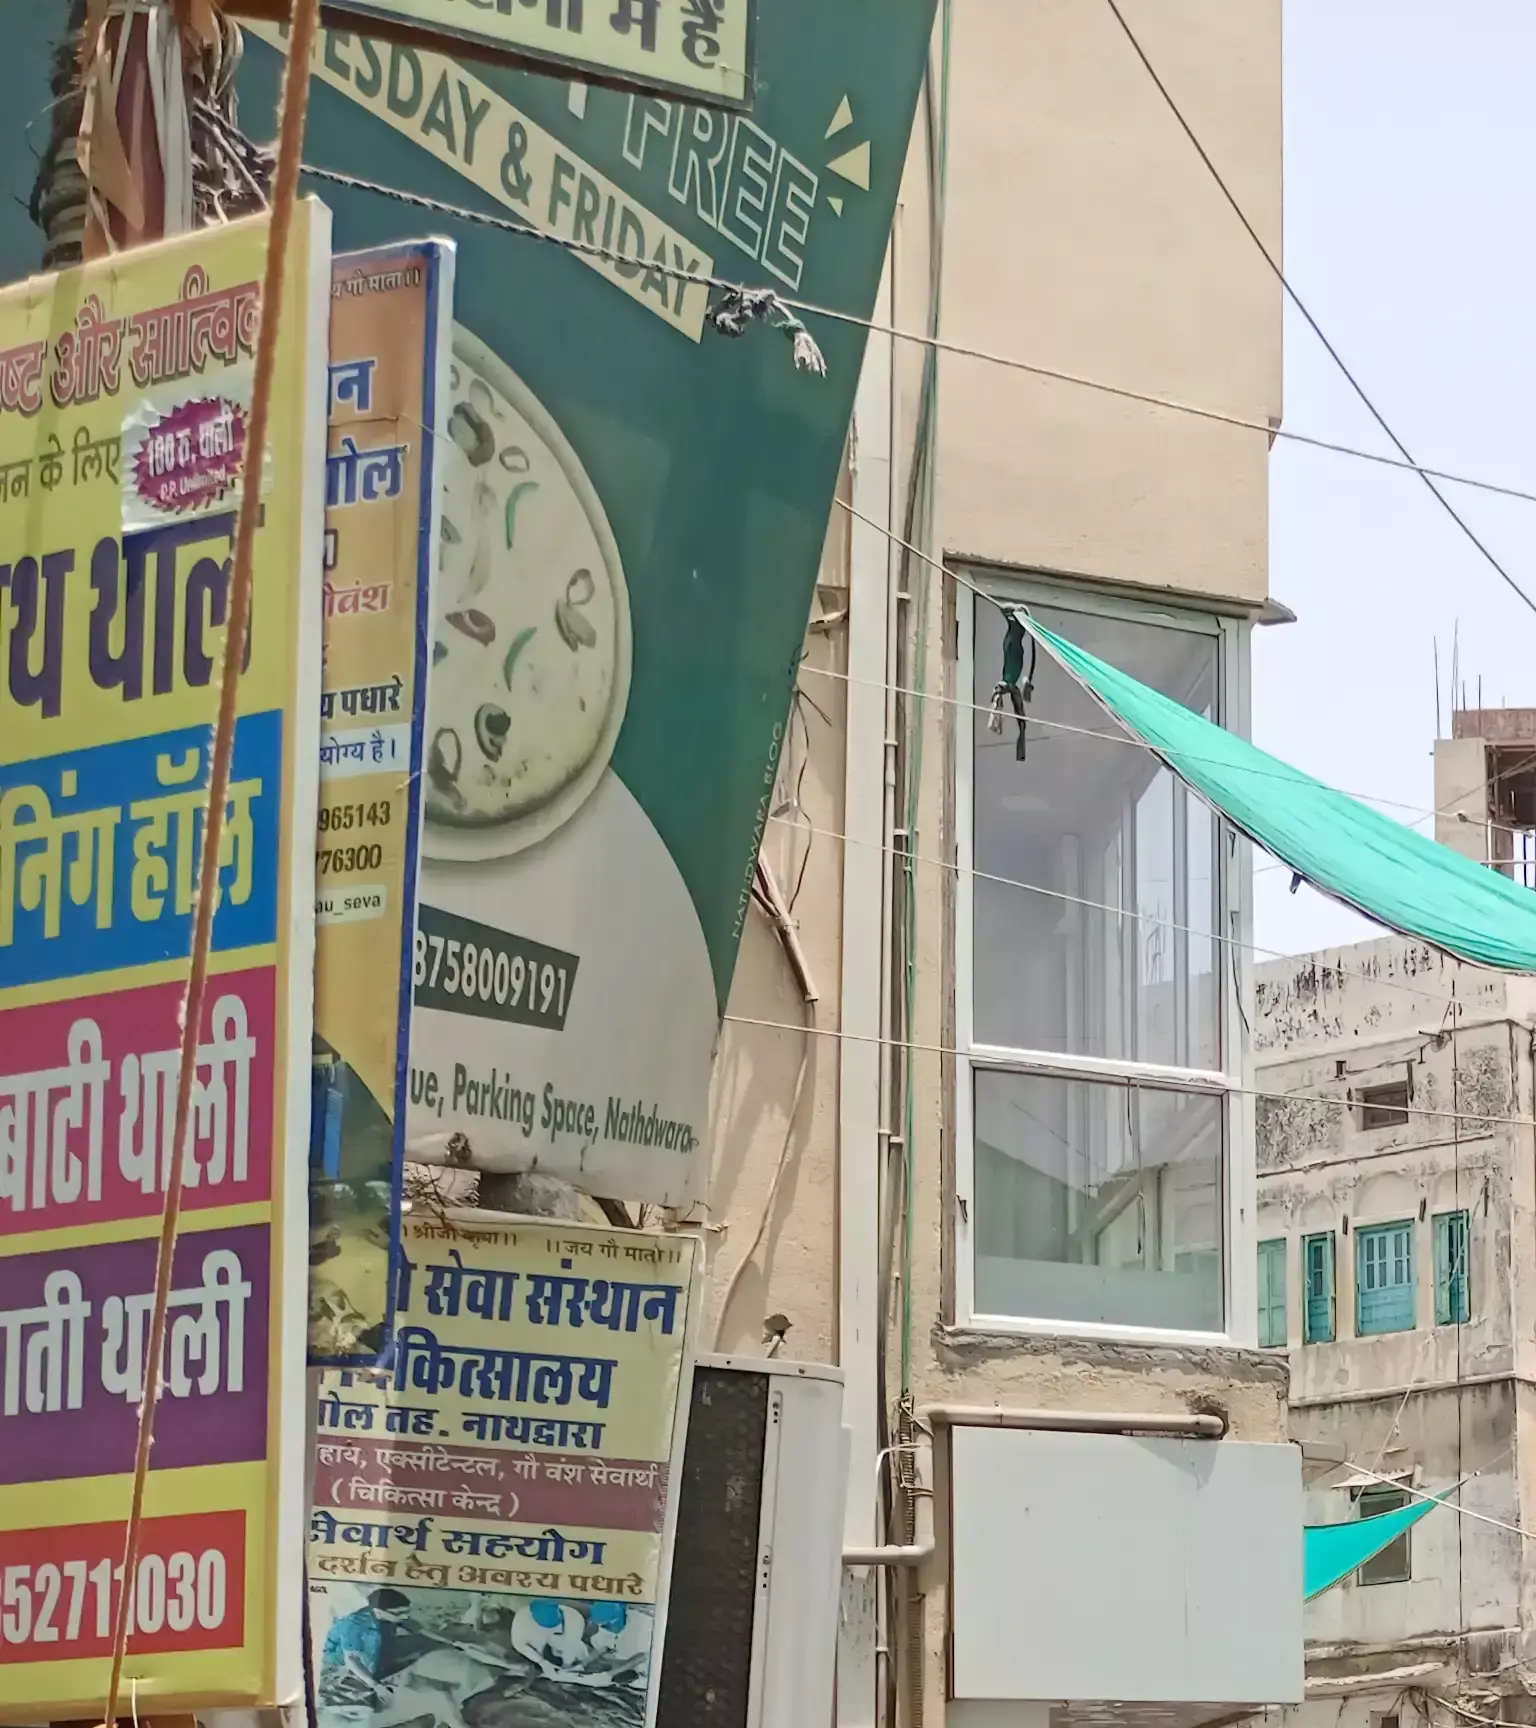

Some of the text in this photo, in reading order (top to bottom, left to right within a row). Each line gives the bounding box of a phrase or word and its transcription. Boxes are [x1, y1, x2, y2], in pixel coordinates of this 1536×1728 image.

[548, 155, 700, 317] FRIDAY
[622, 93, 819, 292] FREE
[50, 294, 122, 410] और
[39, 434, 64, 490] के
[72, 427, 121, 487] लिए
[118, 994, 257, 1194] थाली
[452, 1062, 536, 1138] Parking
[541, 1081, 600, 1145] Space,
[604, 1095, 699, 1154] Nathdwara
[101, 1249, 252, 1403] थाली
[425, 1249, 519, 1324] सेवा
[526, 1258, 684, 1336] संस्थान
[462, 1411, 606, 1450] नाथद्वारा
[545, 1457, 583, 1487] वंश
[0, 1549, 226, 1644] 52711030
